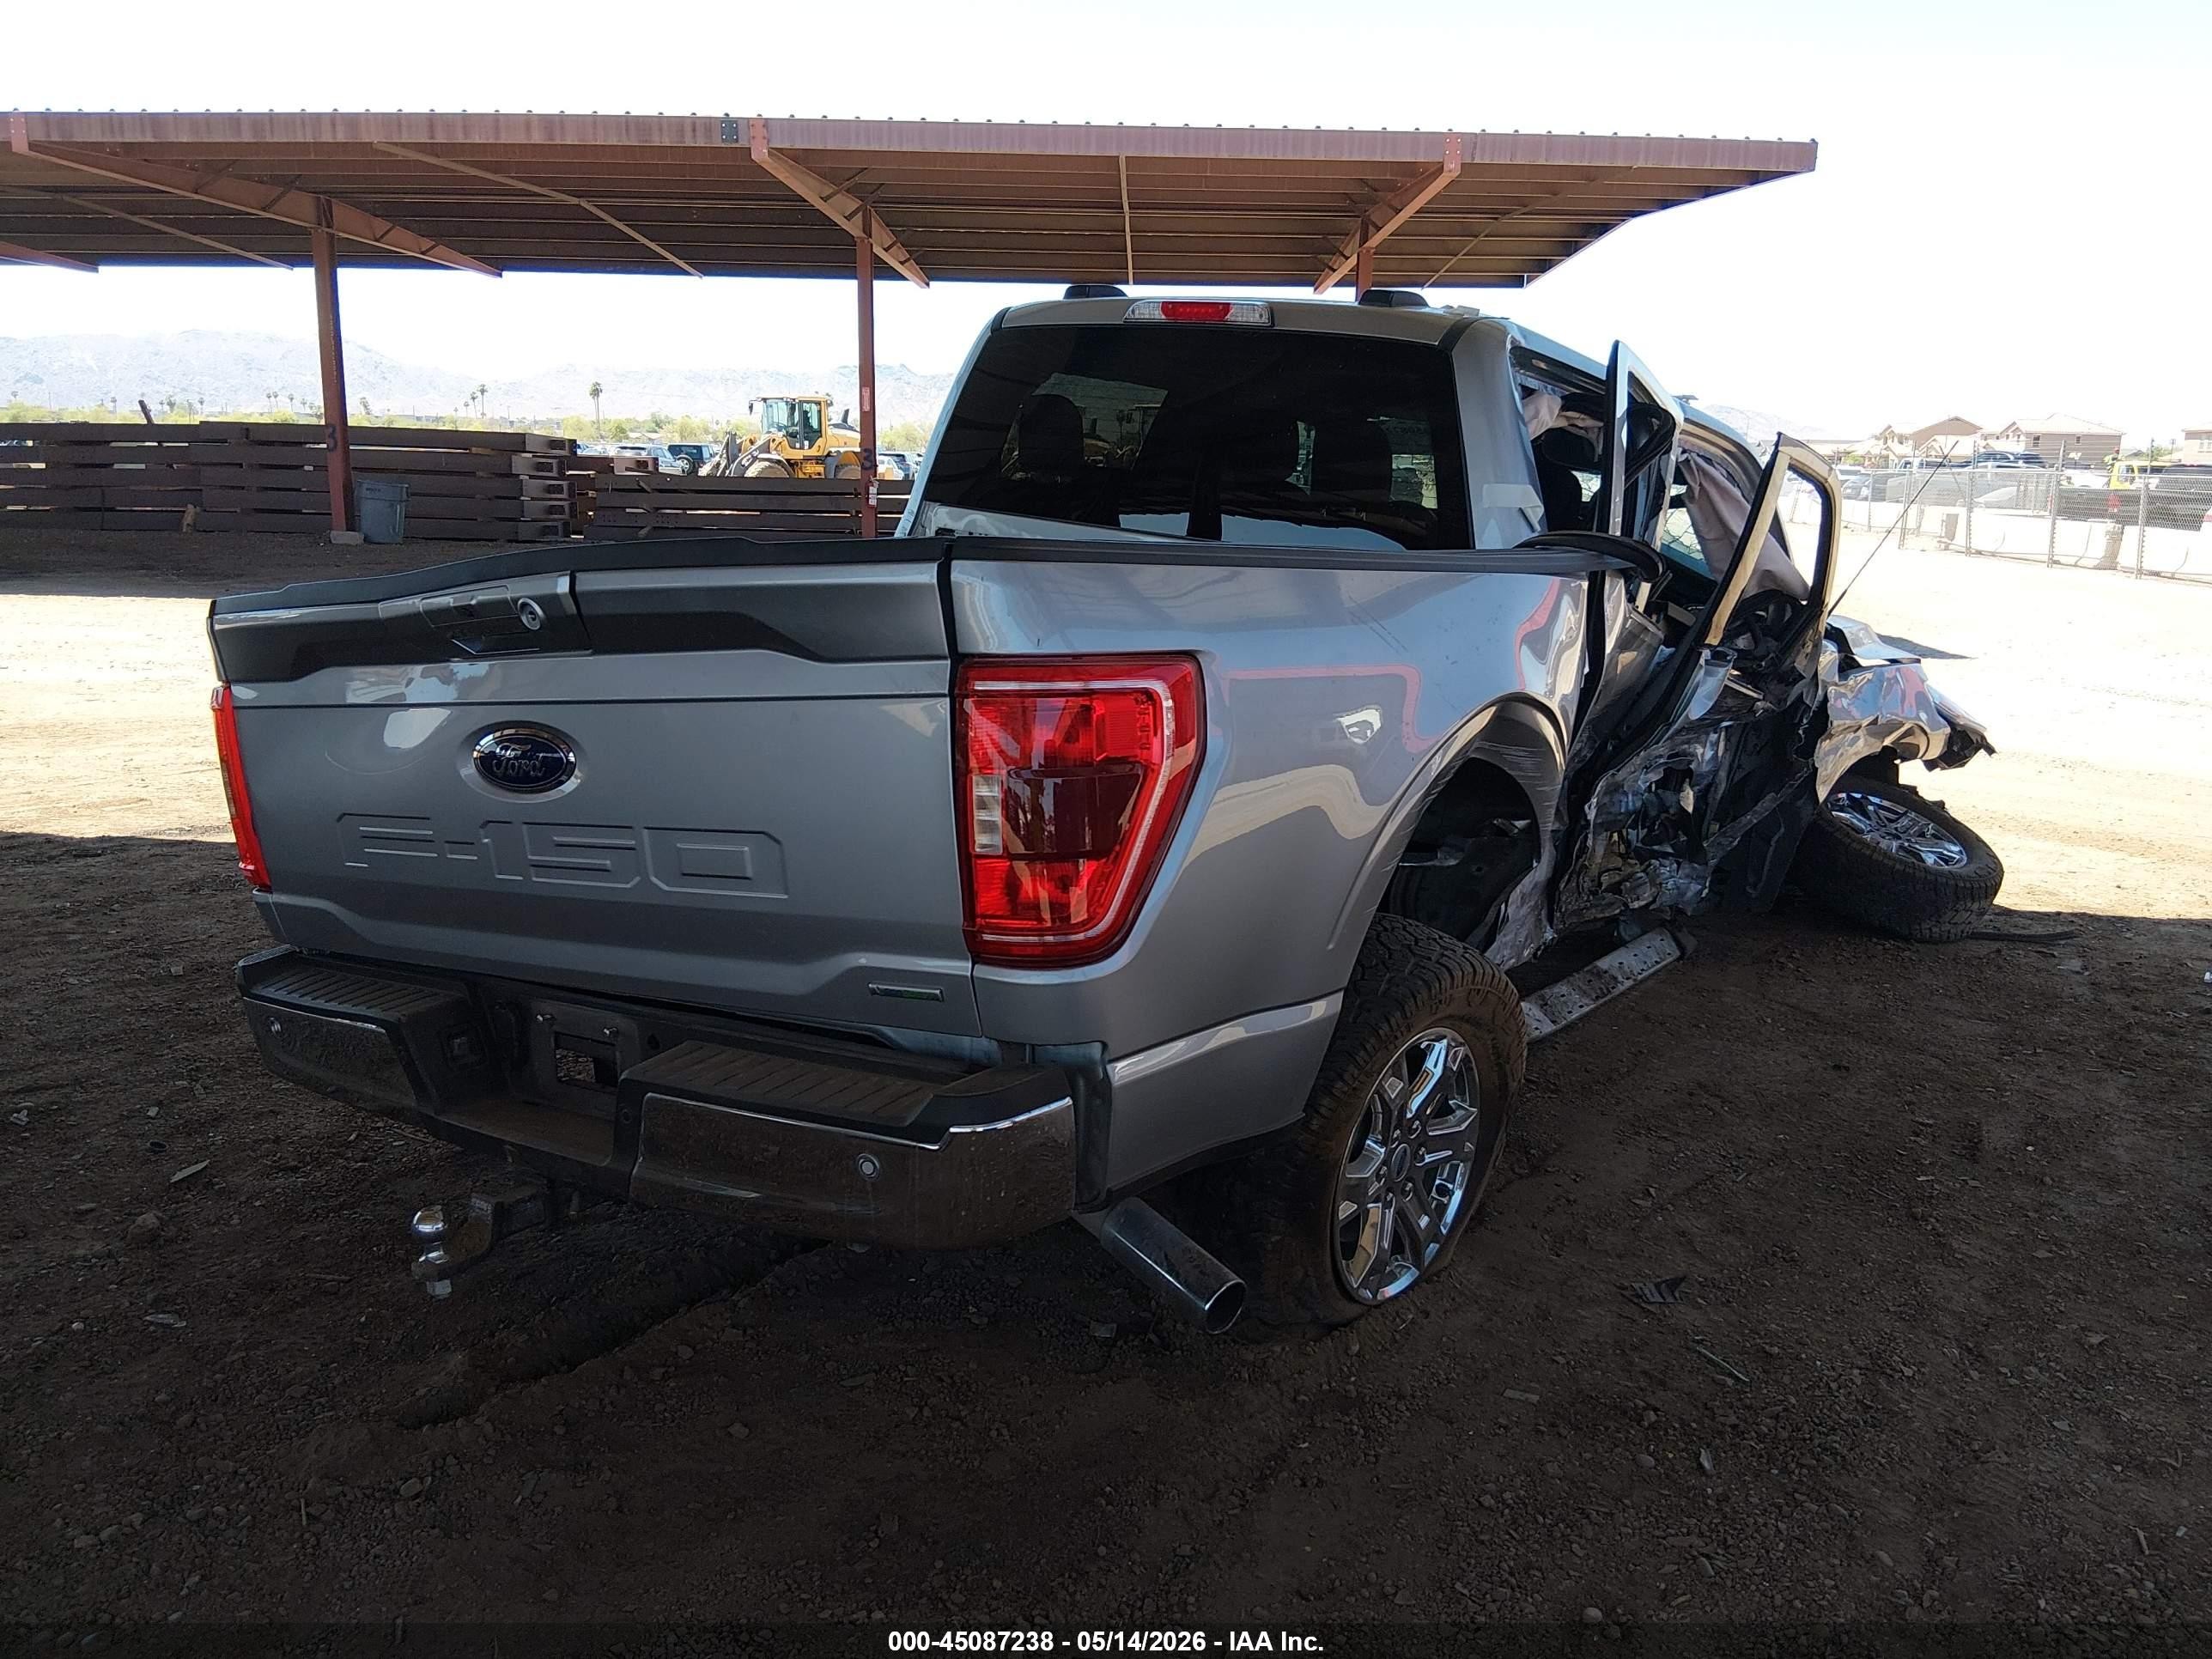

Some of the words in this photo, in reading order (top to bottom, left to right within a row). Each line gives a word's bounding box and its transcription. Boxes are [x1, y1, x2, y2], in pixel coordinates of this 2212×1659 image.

[861, 447, 873, 471] 3
[492, 742, 546, 776] Ford
[337, 811, 789, 900] F-150
